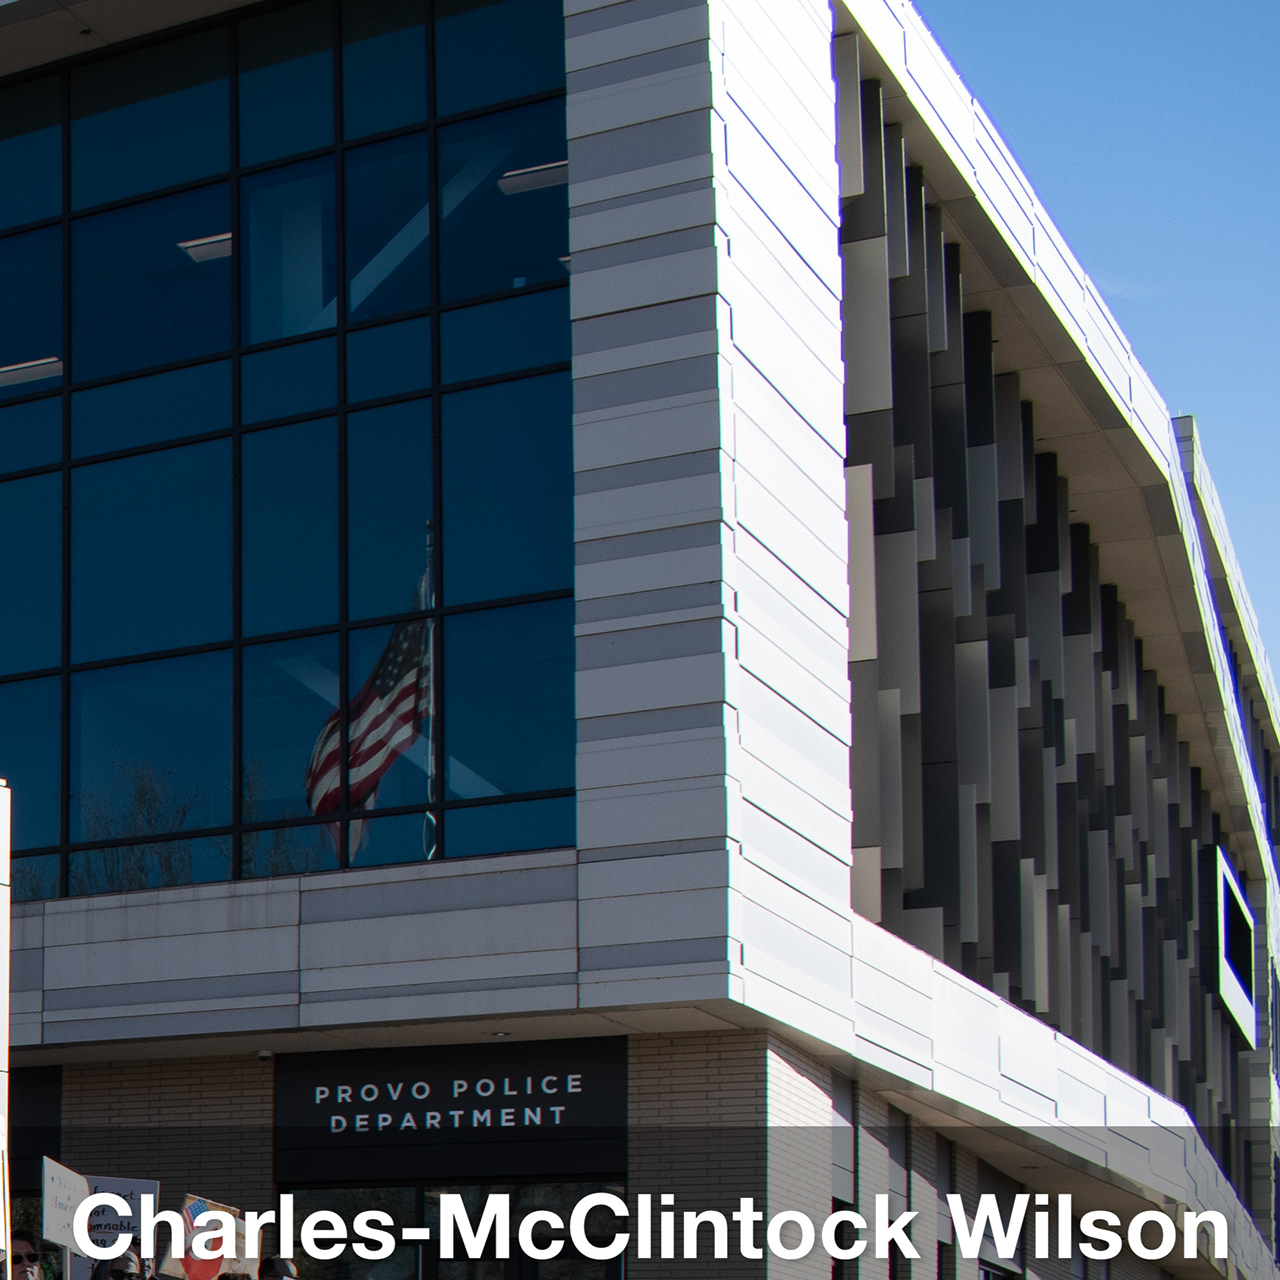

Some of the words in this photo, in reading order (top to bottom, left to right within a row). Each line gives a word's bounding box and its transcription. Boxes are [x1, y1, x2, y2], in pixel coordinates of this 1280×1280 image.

[315, 1081, 431, 1104] PROVO
[453, 1074, 583, 1098] POLICE
[330, 1106, 566, 1133] DEPARTMENT
